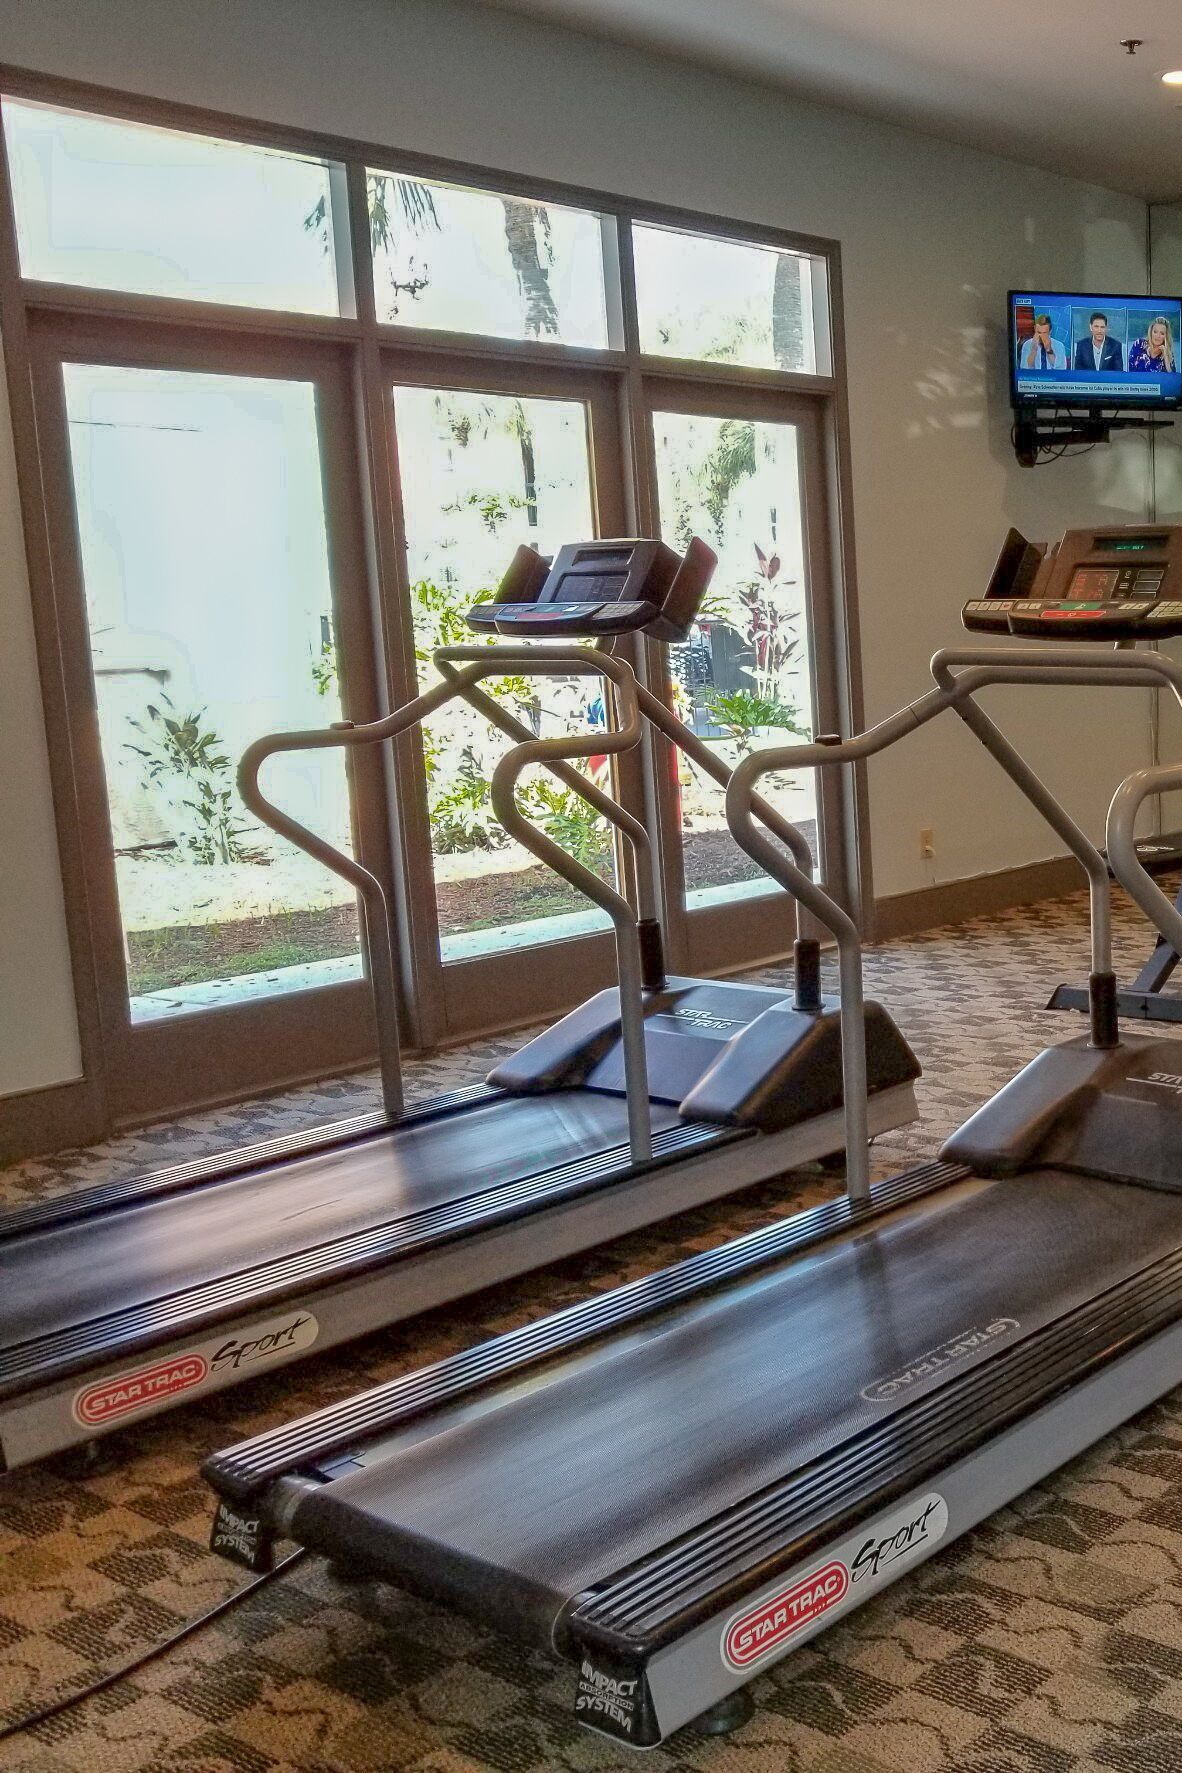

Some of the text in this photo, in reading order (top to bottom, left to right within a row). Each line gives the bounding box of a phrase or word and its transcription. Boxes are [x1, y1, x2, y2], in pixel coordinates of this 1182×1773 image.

[690, 1018, 733, 1030] TRAC
[90, 1317, 312, 1411] STAR TRAC Sport
[876, 1322, 1007, 1396] STAR TRAC
[219, 1503, 260, 1534] IMPACT
[214, 1534, 255, 1565] SYSTEM
[739, 1499, 941, 1649] STAR TRAC Sport
[581, 1660, 638, 1696] IMPACT
[575, 1695, 632, 1733] SYSTEM
